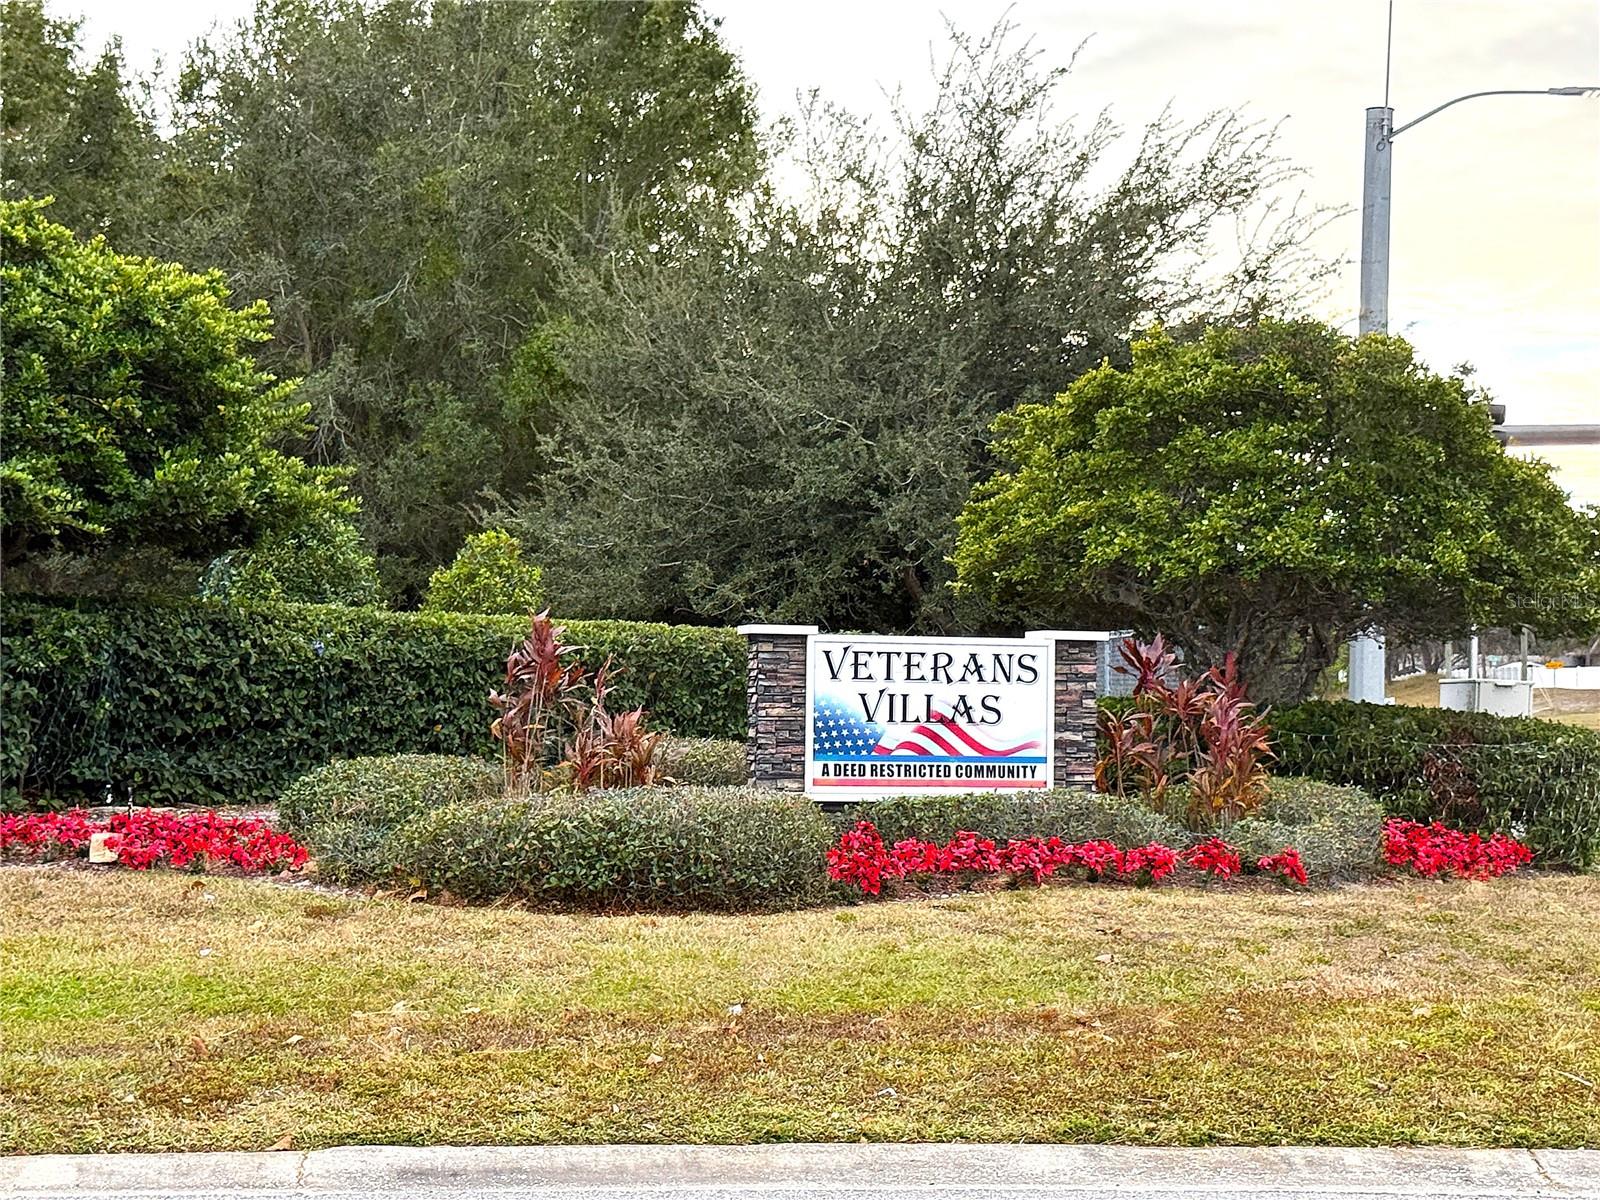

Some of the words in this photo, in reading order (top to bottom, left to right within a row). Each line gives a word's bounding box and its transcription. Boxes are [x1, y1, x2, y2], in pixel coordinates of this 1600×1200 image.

[823, 645, 1038, 684] VETERANS
[859, 687, 1002, 724] VILLAS
[821, 763, 830, 777] A
[834, 763, 866, 777] DEED
[871, 764, 951, 778] RESTRICTED
[956, 765, 1037, 779] COMMUNITY
